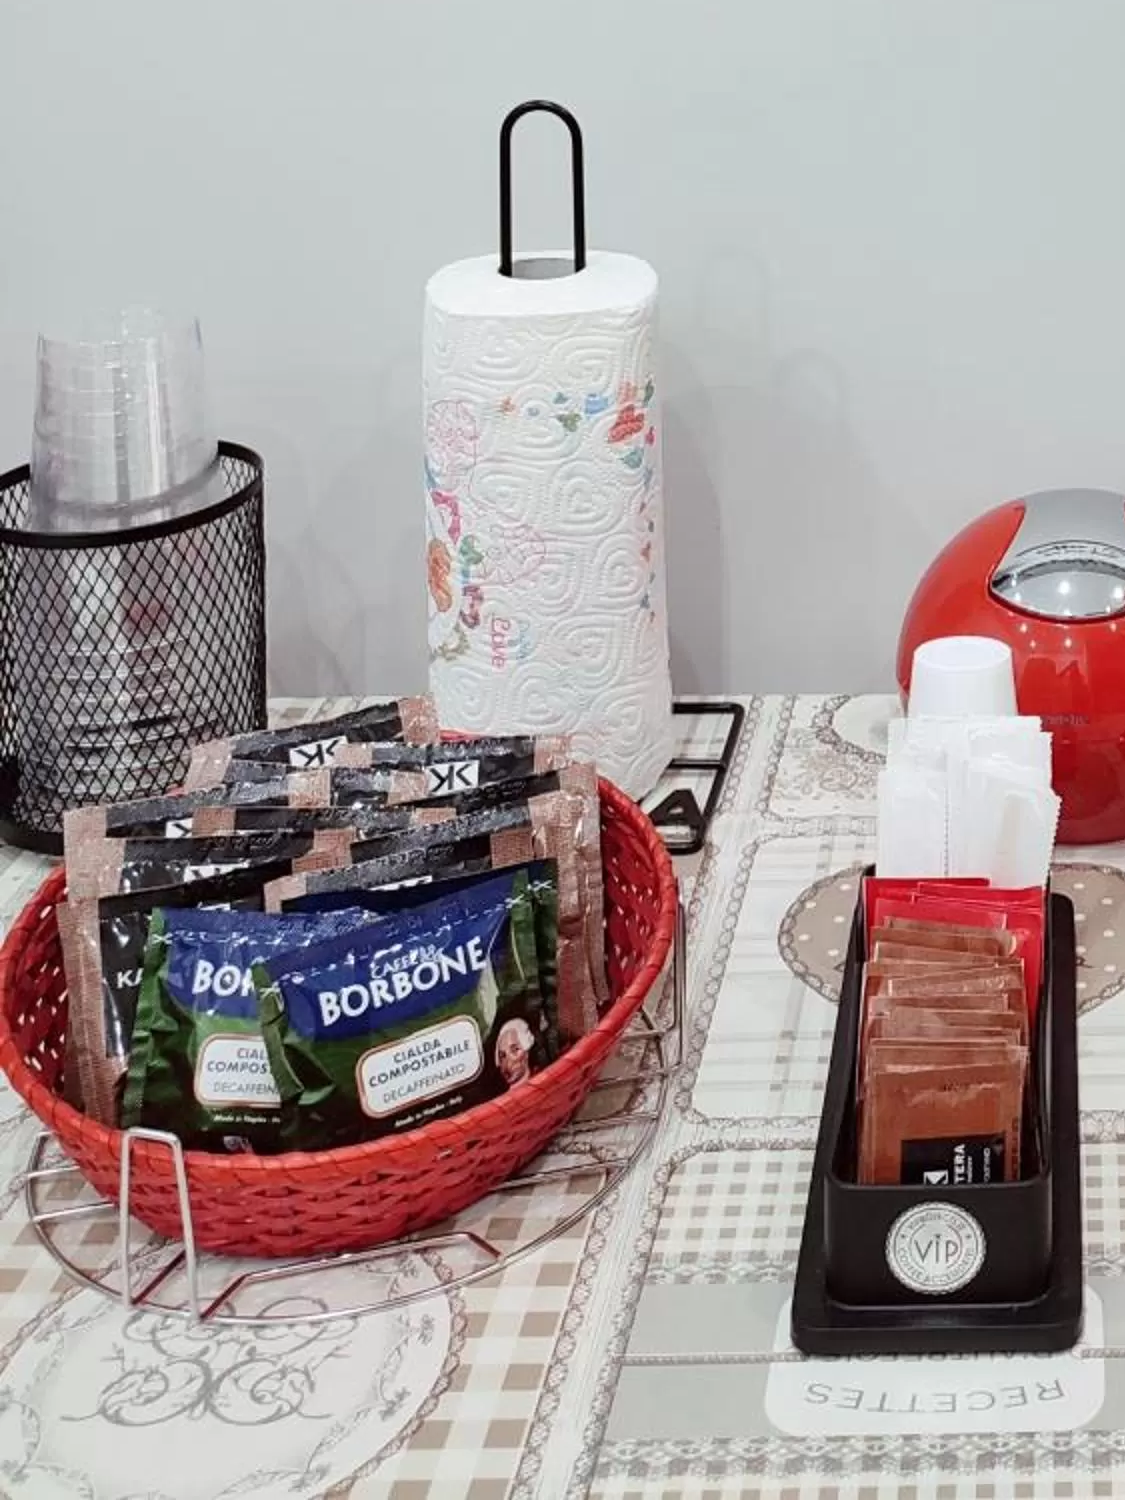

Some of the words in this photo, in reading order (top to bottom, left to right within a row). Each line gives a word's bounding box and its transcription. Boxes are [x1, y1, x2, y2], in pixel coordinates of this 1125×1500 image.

[317, 934, 488, 1028] BORBONE
[368, 1040, 471, 1087] COMPOSTABILE
[392, 1038, 442, 1063] CIALDA
[212, 1081, 279, 1095] DECAFFEIN
[382, 1062, 465, 1104] DECAFFEINATO
[803, 1378, 1066, 1414] RECETTES
